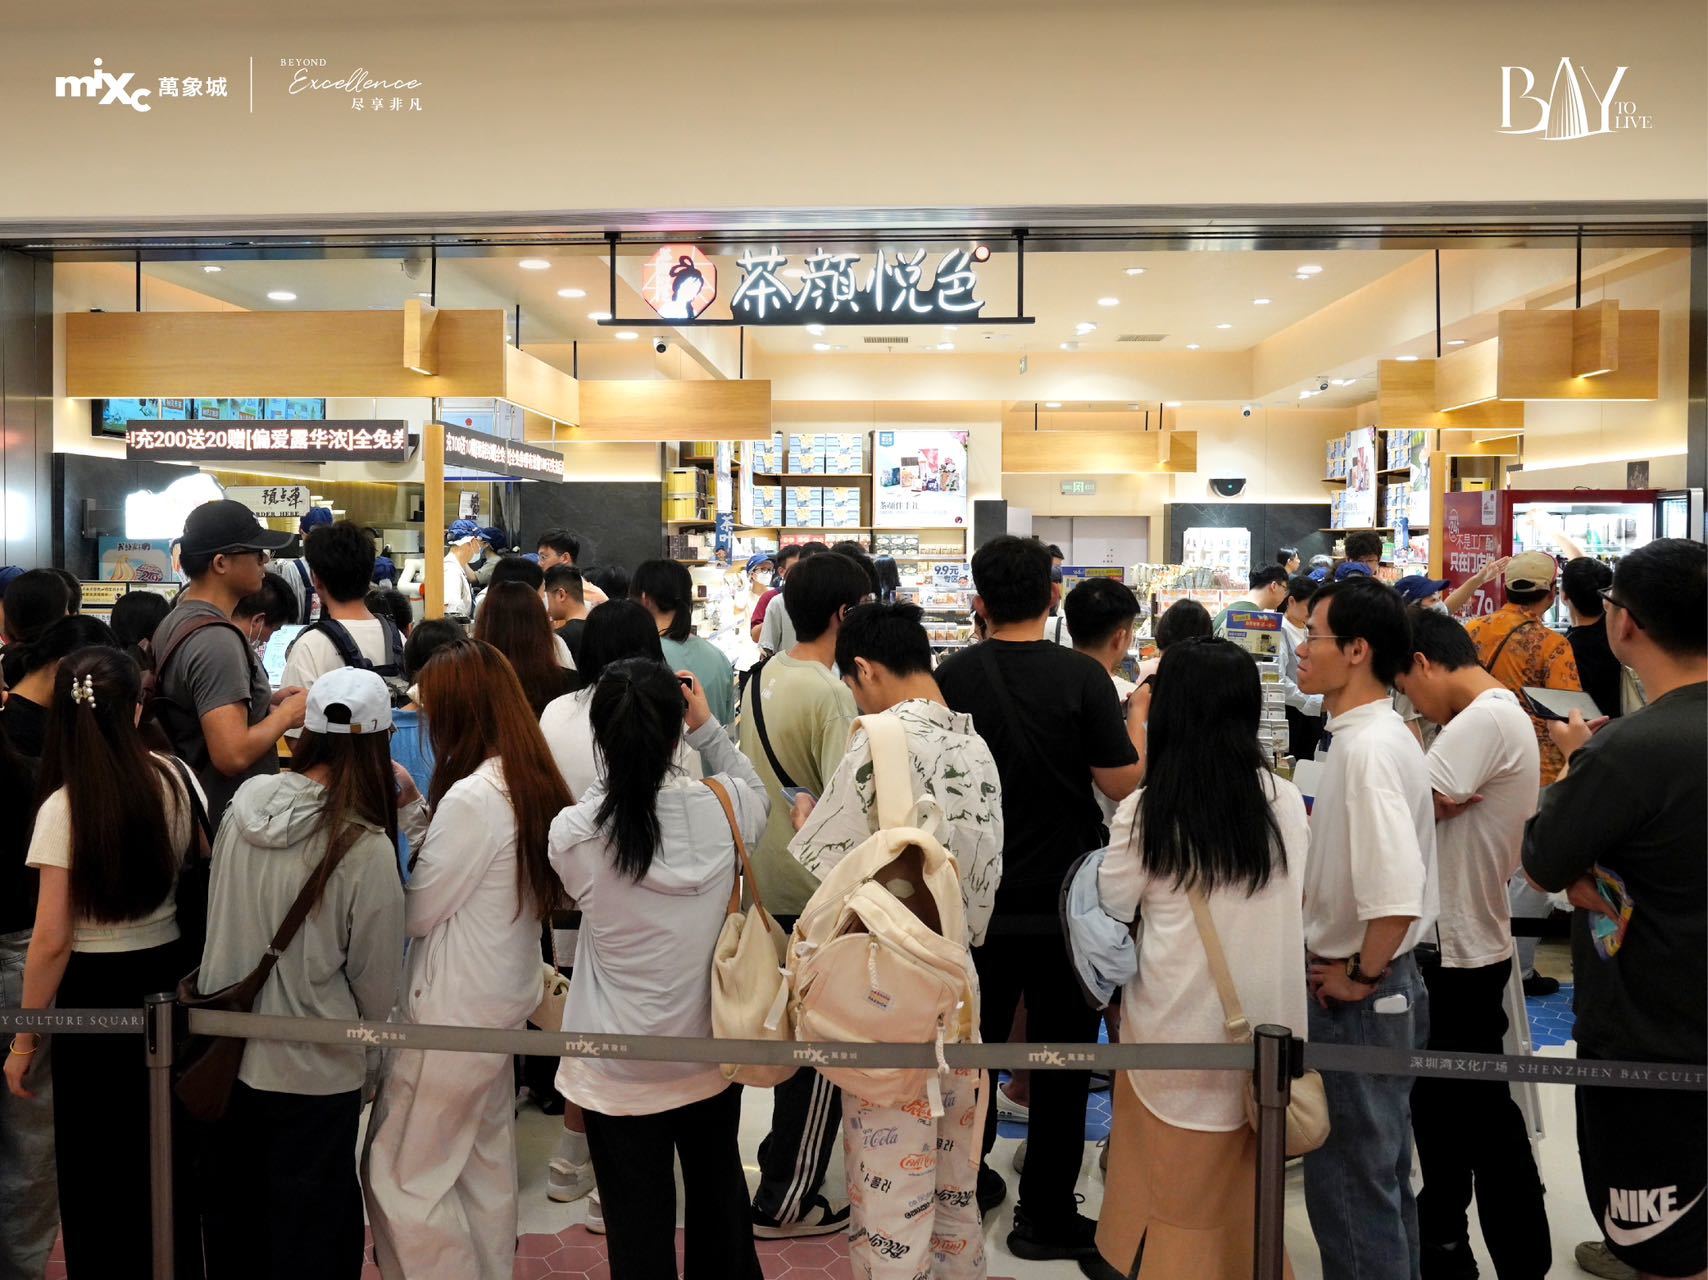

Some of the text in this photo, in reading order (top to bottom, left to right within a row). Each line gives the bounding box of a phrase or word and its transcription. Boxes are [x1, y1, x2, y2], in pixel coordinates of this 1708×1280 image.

[934, 565, 960, 575] 9.9元
[15, 1015, 84, 1026] CULTURE
[1409, 1056, 1705, 1084] 深圳湾文化广场 SHENZHEN BAY CULT
[1609, 1184, 1678, 1223] NIKE
